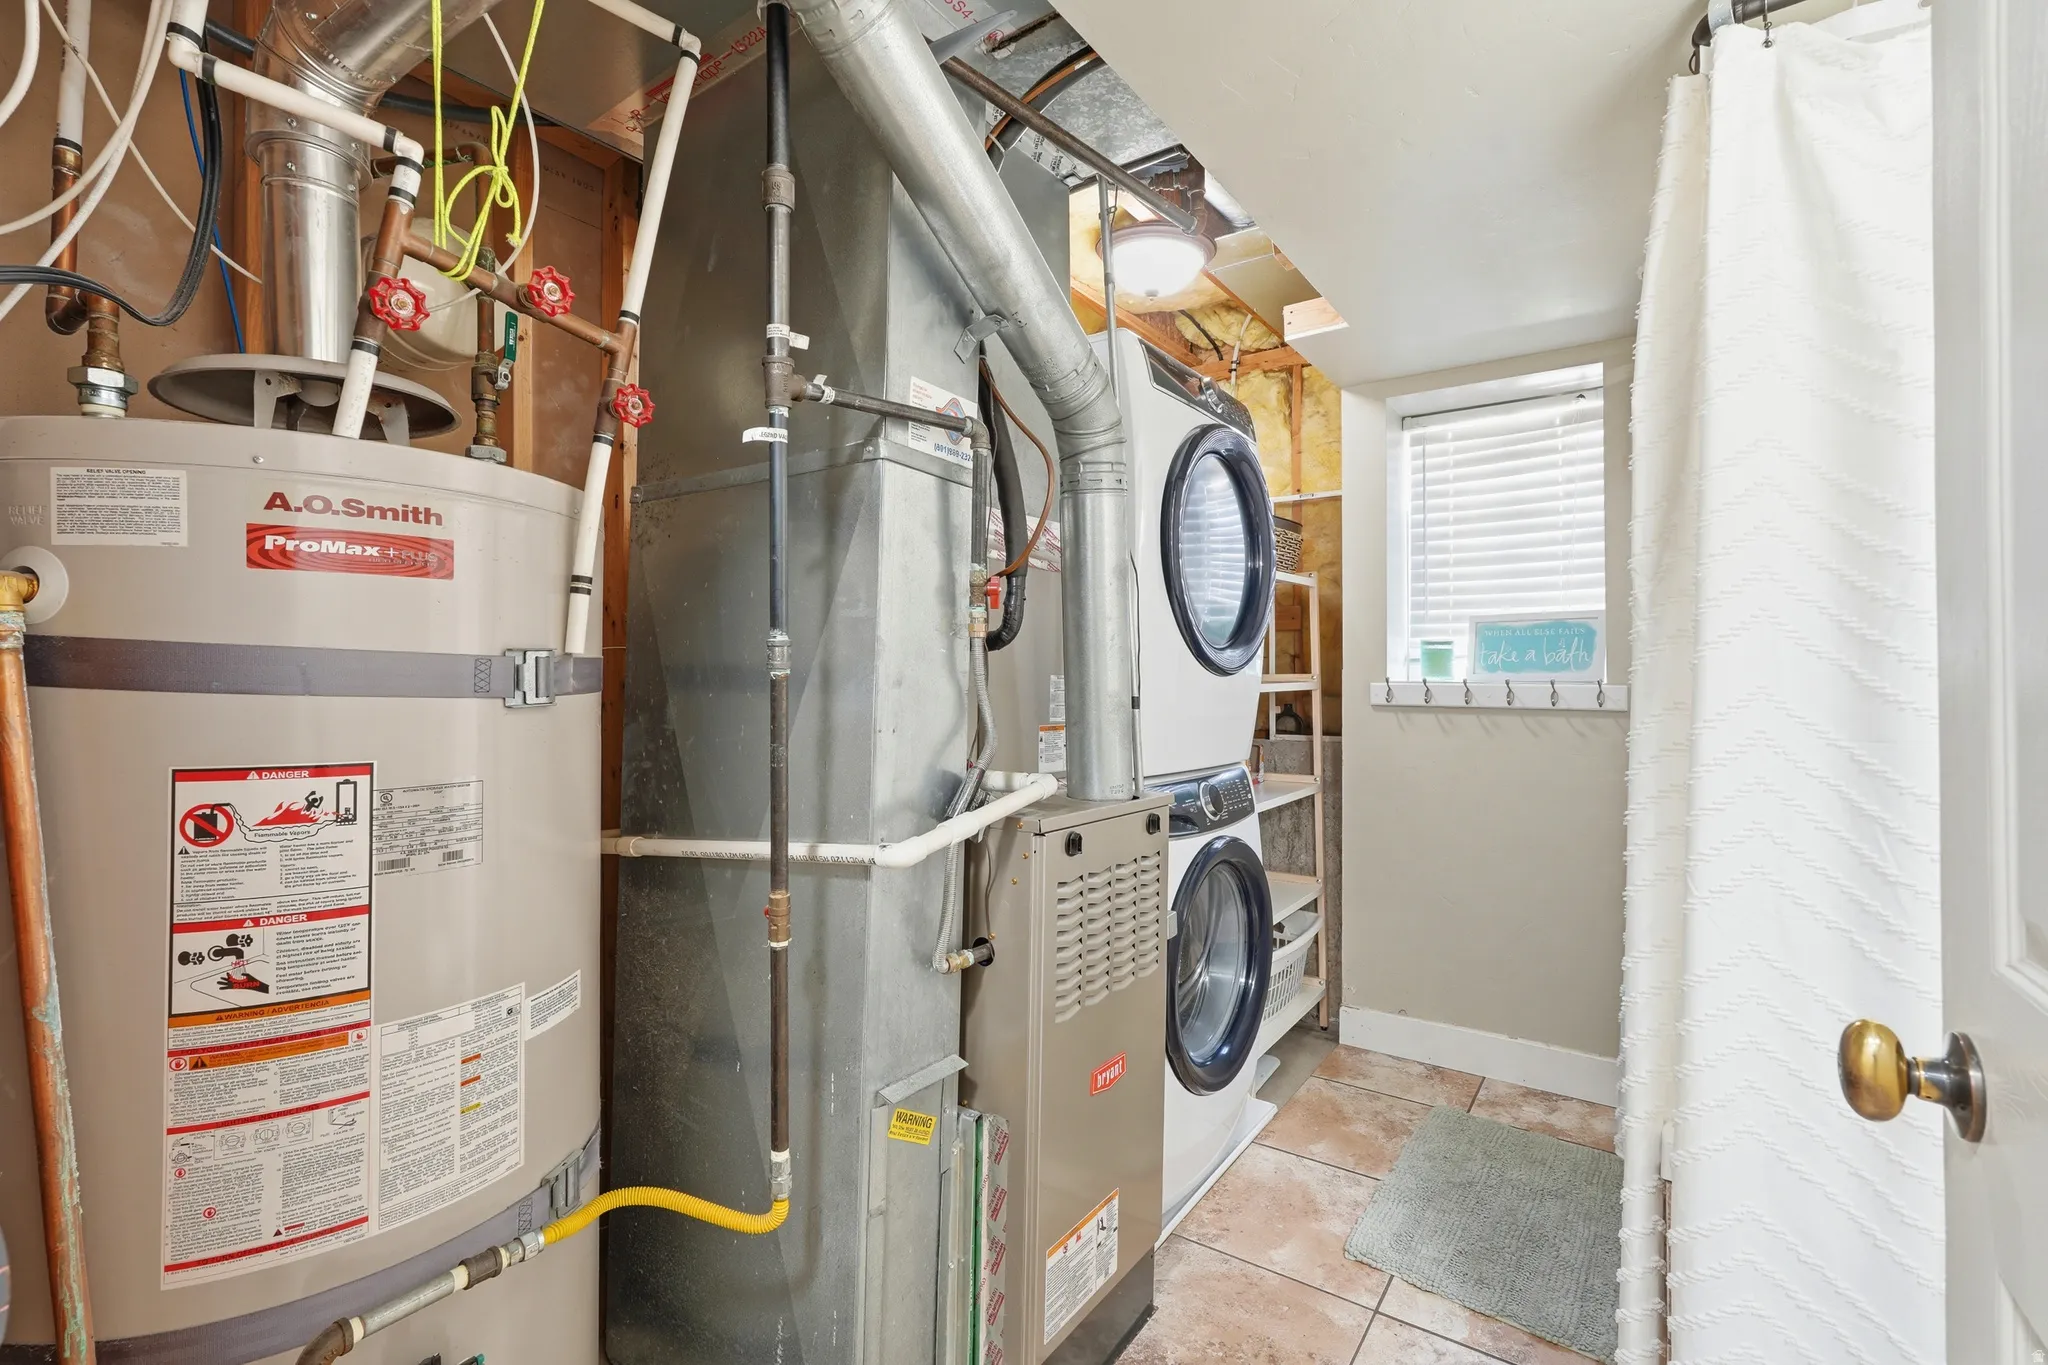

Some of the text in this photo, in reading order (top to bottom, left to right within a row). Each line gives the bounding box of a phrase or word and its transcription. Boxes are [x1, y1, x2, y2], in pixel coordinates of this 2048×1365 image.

[263, 491, 443, 526] A.O.Smith
[264, 534, 381, 557] ProMax
[1484, 626, 1586, 637] WHEN ALL ELSE FAILS
[1480, 637, 1592, 672] take a bath
[261, 770, 309, 780] DANGER
[259, 914, 308, 926] DANGER
[224, 1009, 265, 1021] WARNING
[271, 999, 330, 1014] ADVERTENCIA
[1097, 1060, 1123, 1089] bryant
[896, 1110, 933, 1129] WARNING
